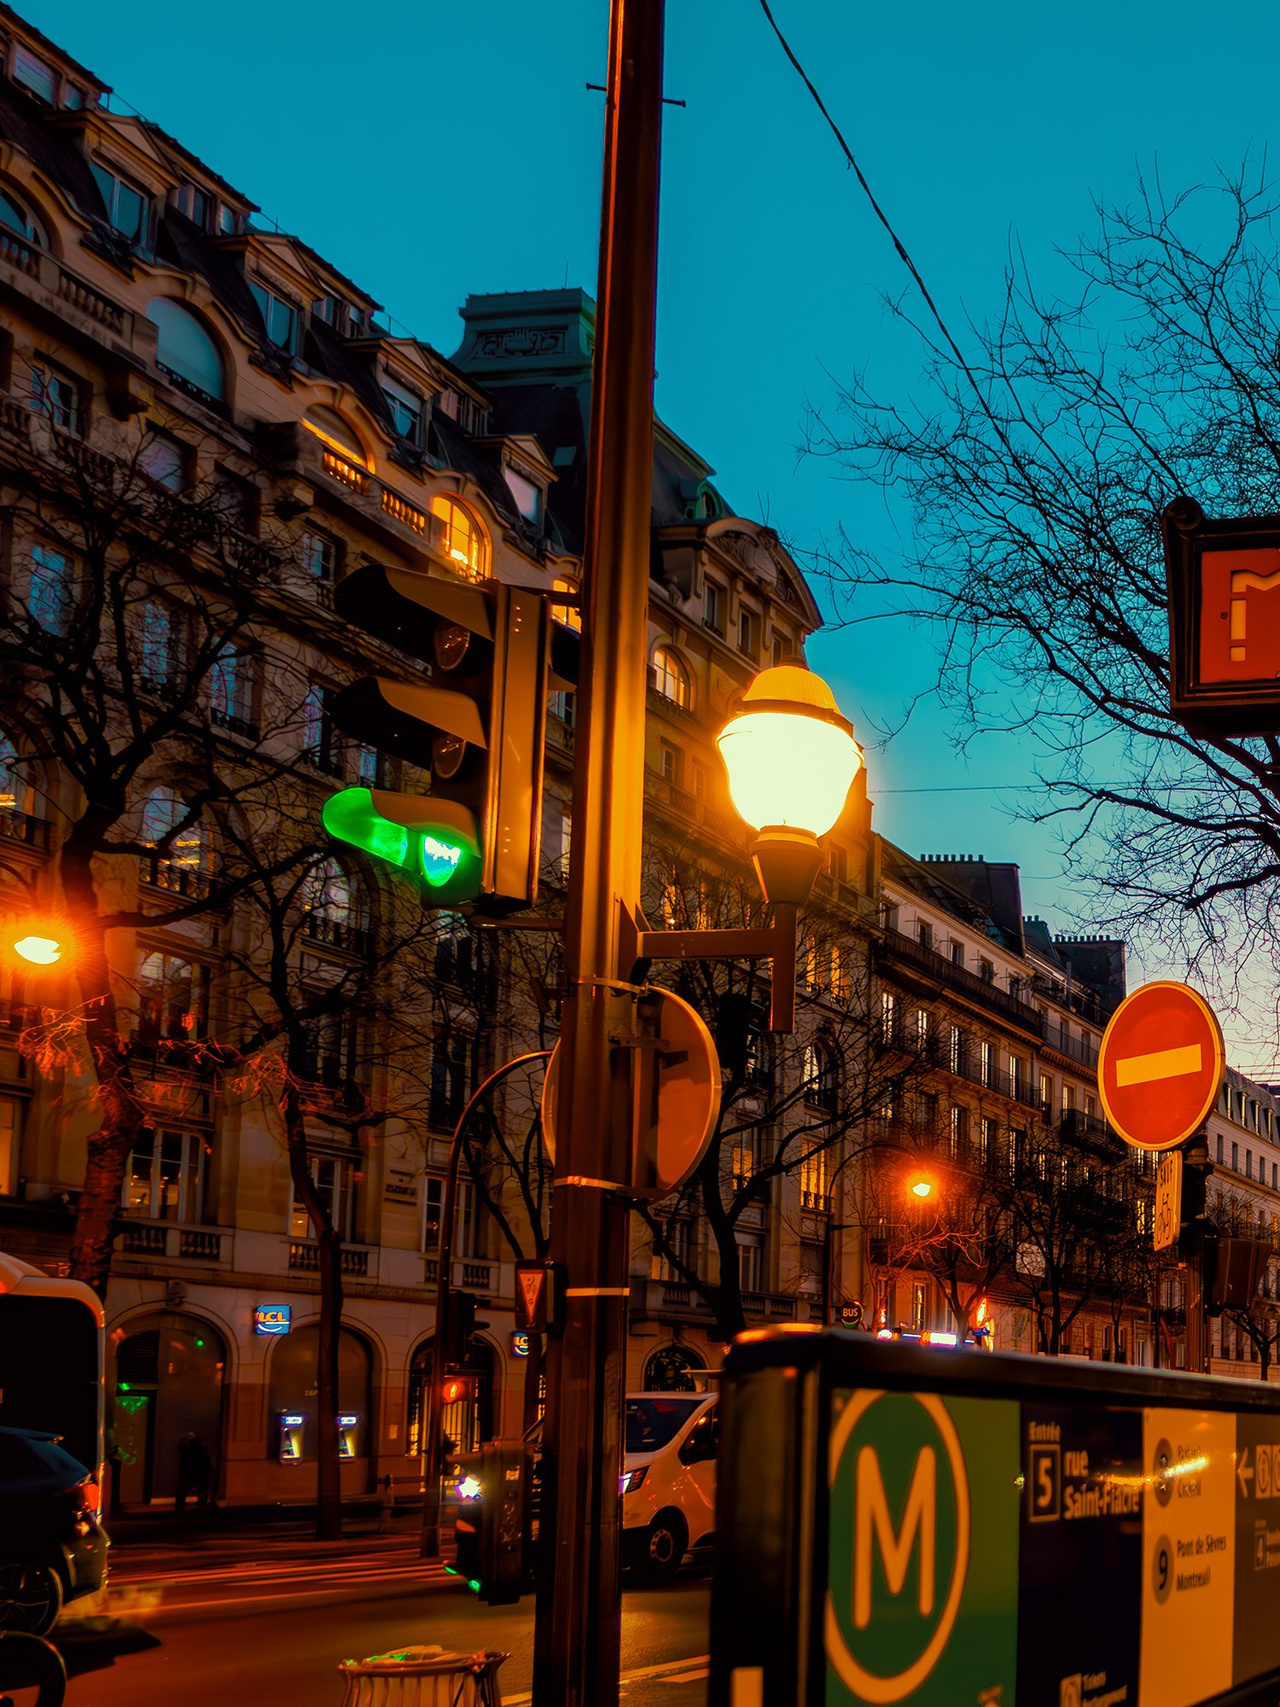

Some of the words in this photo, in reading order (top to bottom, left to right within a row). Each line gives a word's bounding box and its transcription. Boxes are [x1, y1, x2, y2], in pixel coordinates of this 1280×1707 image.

[258, 1311, 287, 1322] LCL
[842, 1308, 858, 1317] BUS
[514, 1336, 529, 1346] LC
[1064, 1450, 1089, 1477] rue
[1036, 1457, 1052, 1508] 5
[1063, 1482, 1140, 1520] Saint-Fiacre
[852, 1444, 936, 1630] M
[1177, 1539, 1194, 1558] Pont
[1196, 1539, 1204, 1554] de
[1159, 1551, 1168, 1590] 9
[1176, 1566, 1211, 1591] Montreuil
